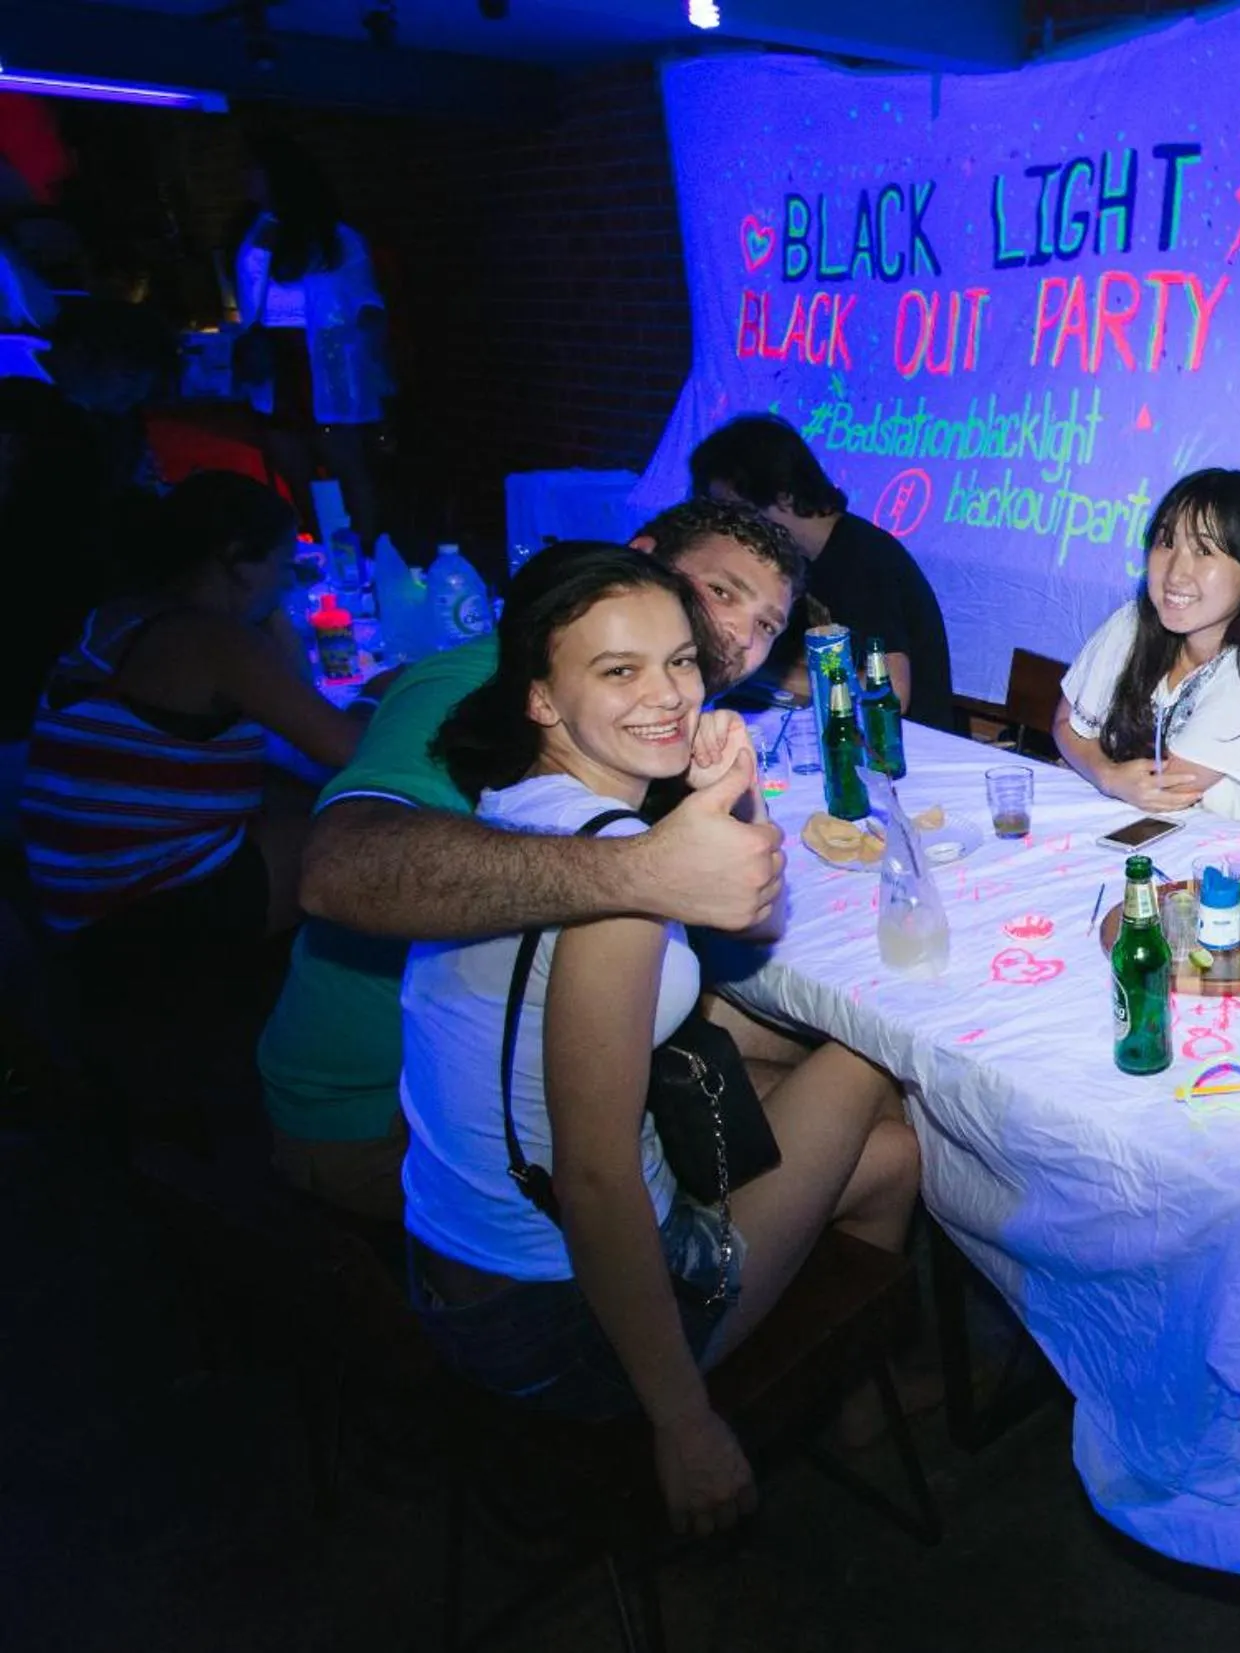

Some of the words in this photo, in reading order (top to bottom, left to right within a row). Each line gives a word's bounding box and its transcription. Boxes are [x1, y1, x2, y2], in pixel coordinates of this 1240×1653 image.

[781, 179, 942, 284] BLACK
[991, 143, 1202, 270] LIGHT
[736, 289, 858, 372] BLACK
[894, 287, 991, 381] OUT
[1029, 269, 1231, 374] PARTY
[801, 386, 1104, 482] #Bedstationblacklight
